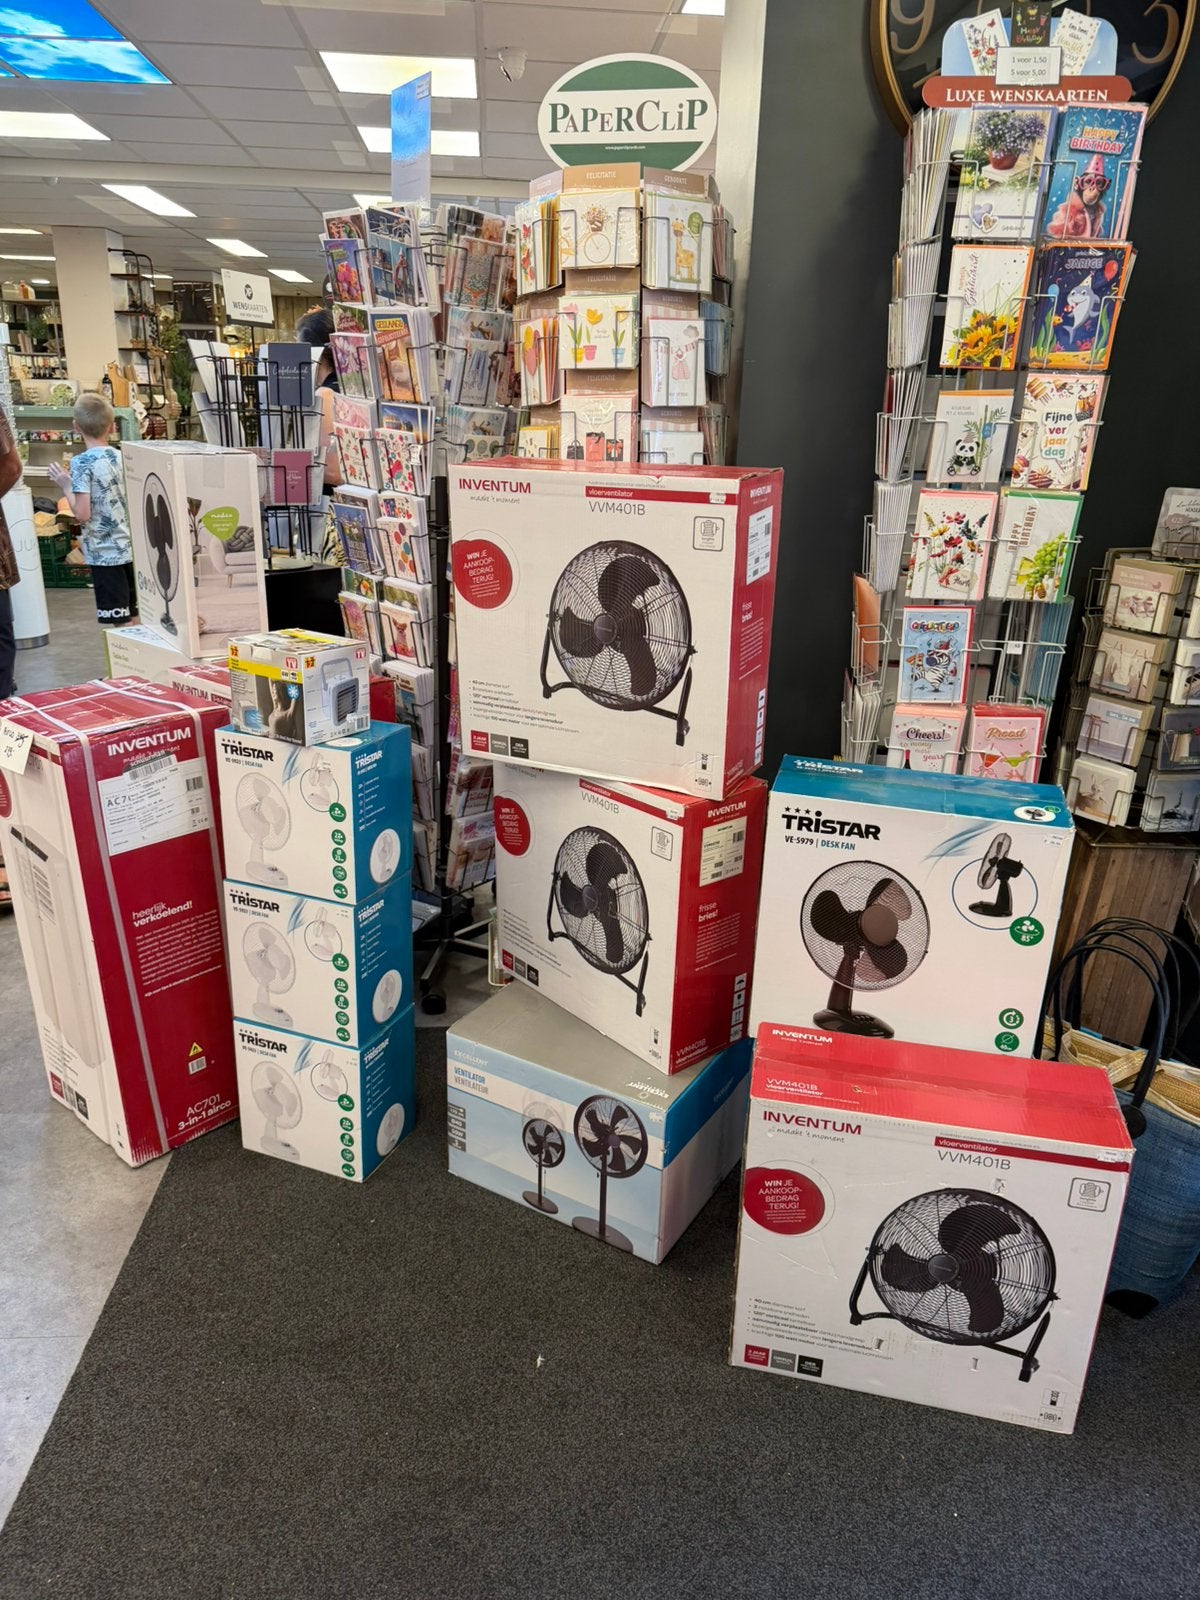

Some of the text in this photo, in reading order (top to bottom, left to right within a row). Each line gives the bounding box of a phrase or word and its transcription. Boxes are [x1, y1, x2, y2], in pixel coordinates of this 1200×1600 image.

[1032, 69, 1047, 77] 5,00
[946, 88, 1109, 102] LUXE WENSKAARTEN
[1083, 127, 1119, 141] HAPPY
[1070, 137, 1125, 154] BIRTHDAY
[1065, 258, 1103, 269] JARIGE
[1045, 412, 1073, 425] Fijne
[1048, 426, 1067, 435] ver
[1044, 437, 1067, 448] jaar
[1044, 449, 1066, 459] dag
[458, 478, 532, 494] INVENTUM
[588, 489, 634, 498] vloerventilator
[589, 500, 646, 516] VVM401B
[1019, 505, 1037, 546] BIRTHDAY
[1008, 523, 1022, 551] HAPPY
[467, 550, 488, 560] WIN JE
[463, 557, 495, 570] AANKOOP-
[469, 565, 494, 577] BEDRAG
[472, 574, 495, 584] TERUG!
[356, 648, 366, 659] TV
[286, 658, 298, 669] TV
[906, 728, 946, 741] Cheers!
[986, 727, 1026, 741] Proost
[107, 727, 191, 756] INVENTUM
[581, 791, 620, 814] VVM401B
[708, 801, 747, 818] INVENTUM
[785, 835, 856, 851] VE-5979 DESK FAN
[132, 902, 167, 920] heerlijk
[133, 900, 193, 928] verkoelend!
[699, 902, 718, 913] frisse
[698, 909, 719, 923] bries!
[772, 1029, 833, 1044] INVENTUM
[454, 1067, 486, 1085] VENTILATOR
[454, 1075, 489, 1095] VENTILATEUR
[766, 1077, 818, 1091] VVM401B
[766, 1083, 824, 1097] vloerventilator
[187, 1093, 221, 1117] AC701
[178, 1100, 232, 1130] 3-in-1 airco
[763, 1110, 862, 1135] INVENTUM
[939, 1139, 998, 1153] vloerventilator
[937, 1150, 1011, 1170] VVM401B
[784, 1179, 793, 1187] JE
[758, 1187, 803, 1195] AANKOOP-
[765, 1194, 799, 1203] BEDRAG
[768, 1202, 800, 1210] TERUG!
